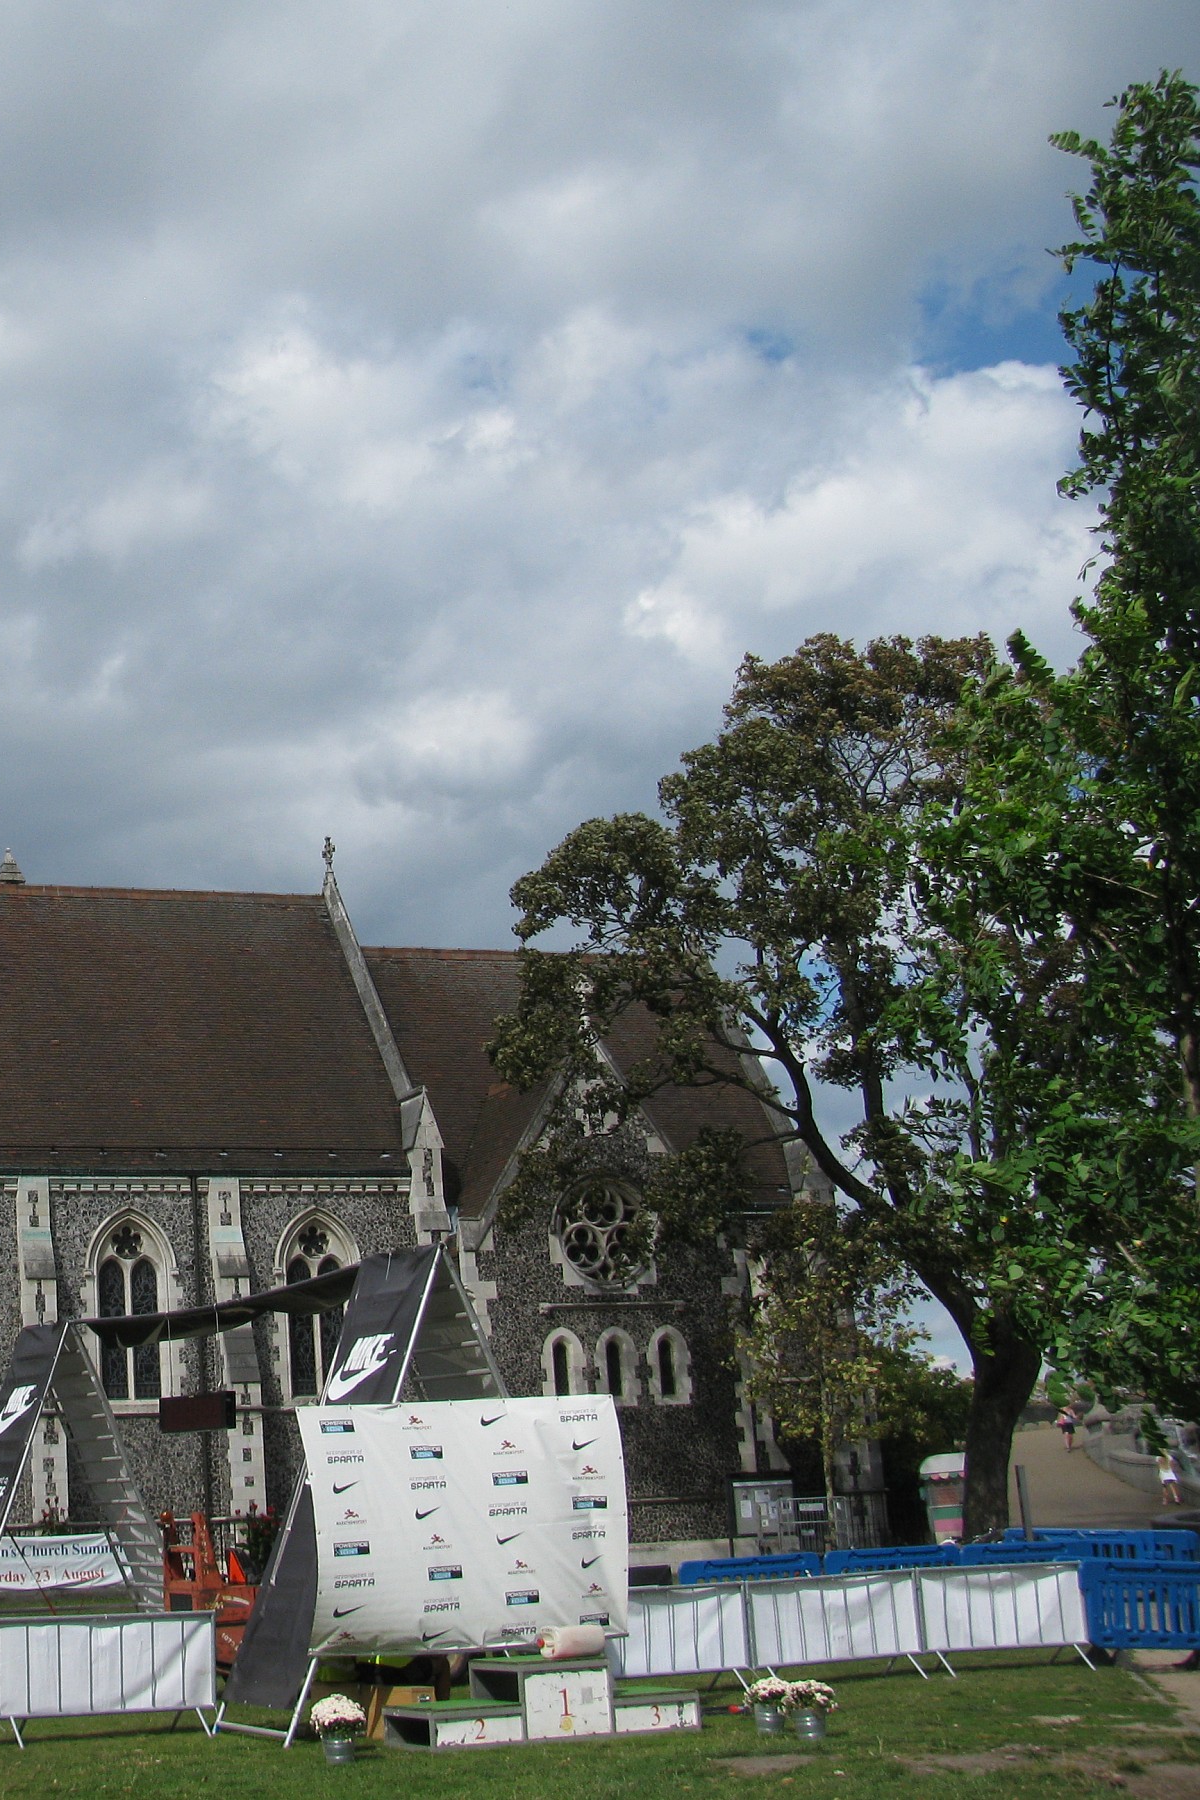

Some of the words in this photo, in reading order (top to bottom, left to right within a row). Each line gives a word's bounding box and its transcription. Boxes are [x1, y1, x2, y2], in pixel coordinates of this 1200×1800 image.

[560, 1413, 598, 1422] SPARTA
[327, 1455, 364, 1464] SPARTA
[411, 1481, 446, 1490] SPARTA
[488, 1507, 528, 1517] SPARTA
[572, 1530, 606, 1540] SPARTA
[21, 1544, 69, 1557] Church
[35, 1569, 50, 1582] 23
[61, 1567, 105, 1582] August
[334, 1578, 375, 1588] SPARTA
[424, 1602, 460, 1612] SPARTA
[501, 1626, 537, 1637] SPARTA
[559, 1688, 573, 1717] 1
[651, 1705, 661, 1726] 3
[474, 1718, 486, 1740] 2
